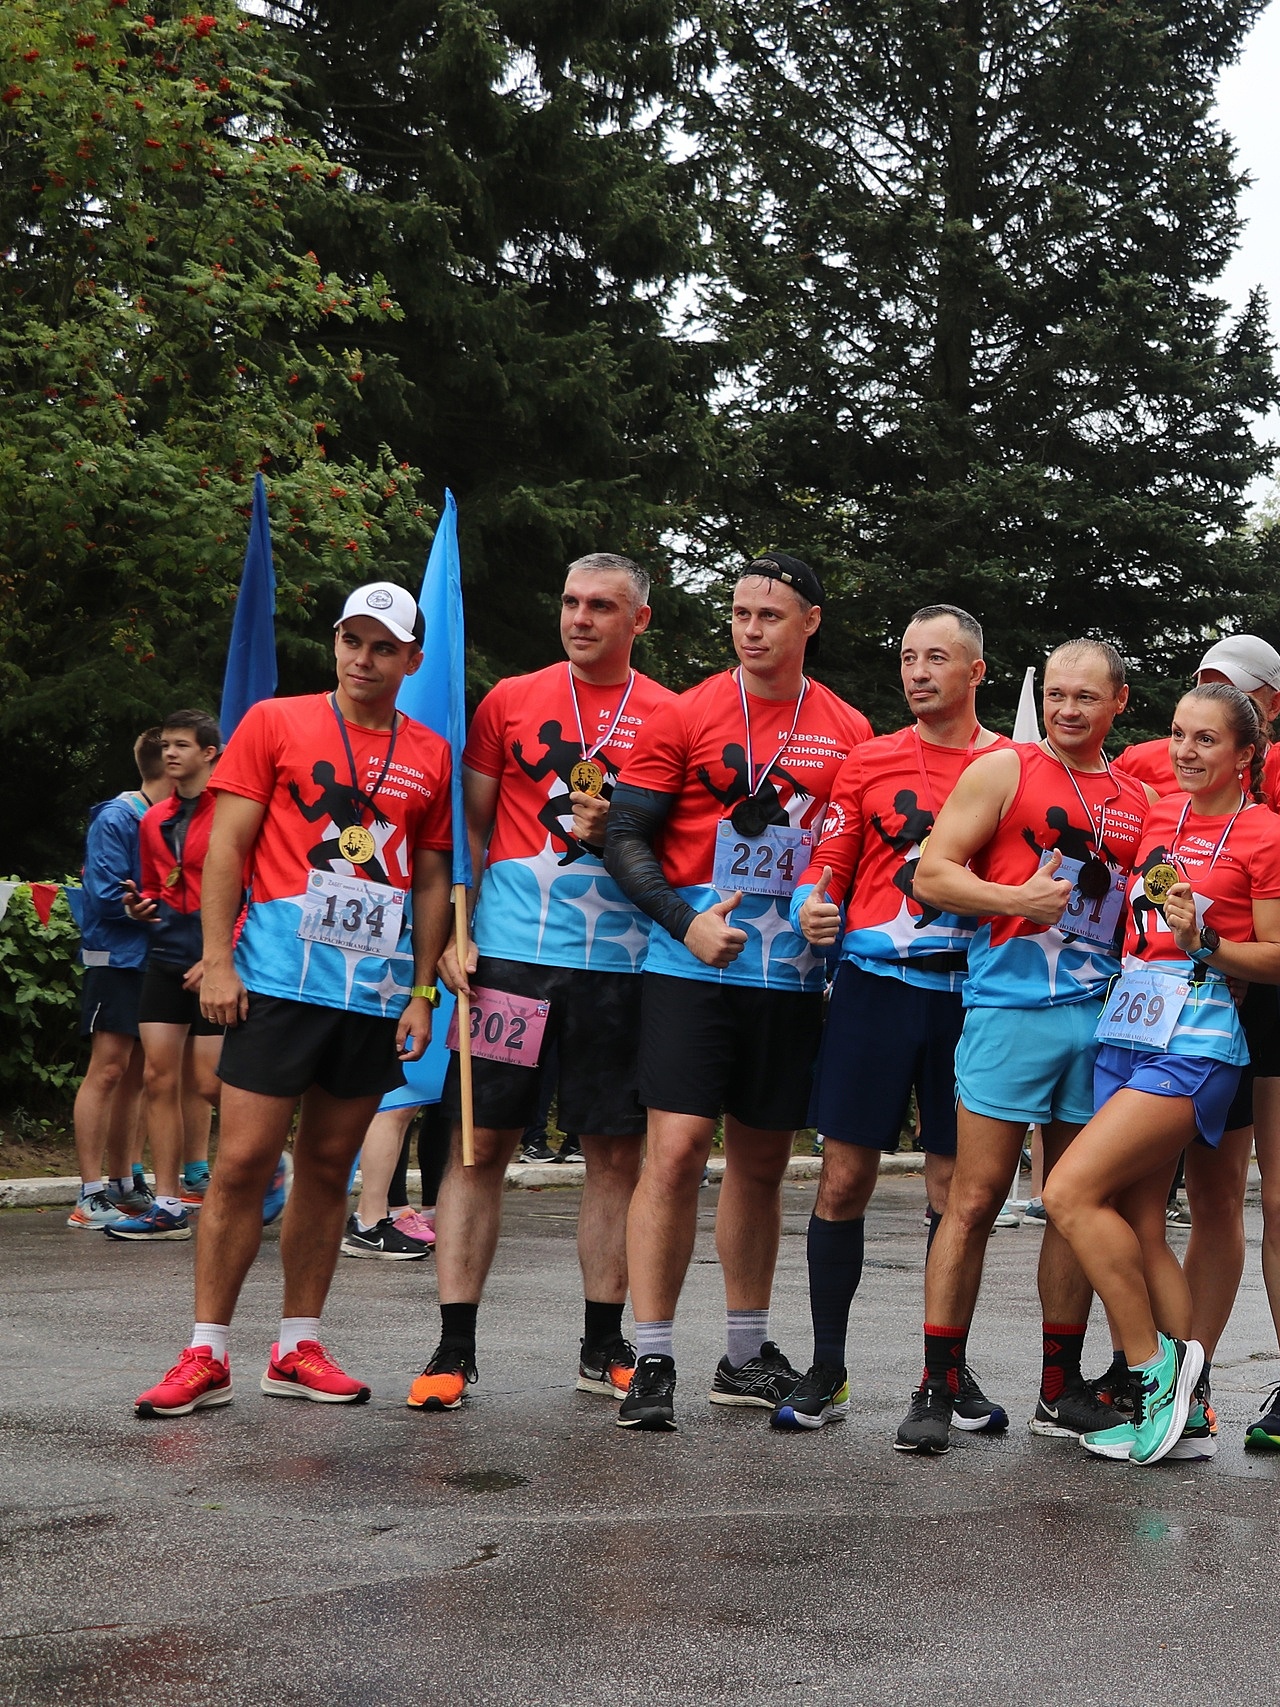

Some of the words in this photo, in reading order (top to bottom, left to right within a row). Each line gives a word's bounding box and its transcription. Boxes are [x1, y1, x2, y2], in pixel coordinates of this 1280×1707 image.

[598, 709, 611, 719] И
[778, 731, 788, 740] И
[790, 733, 837, 745] звезды
[368, 756, 379, 766] И
[780, 756, 824, 769] ближе
[1093, 803, 1103, 813] И
[1096, 827, 1135, 843] лиже
[731, 843, 795, 881] 224
[1053, 876, 1102, 924] 31
[321, 894, 385, 939] 134
[1109, 991, 1166, 1027] 269
[468, 1006, 528, 1051] 302
